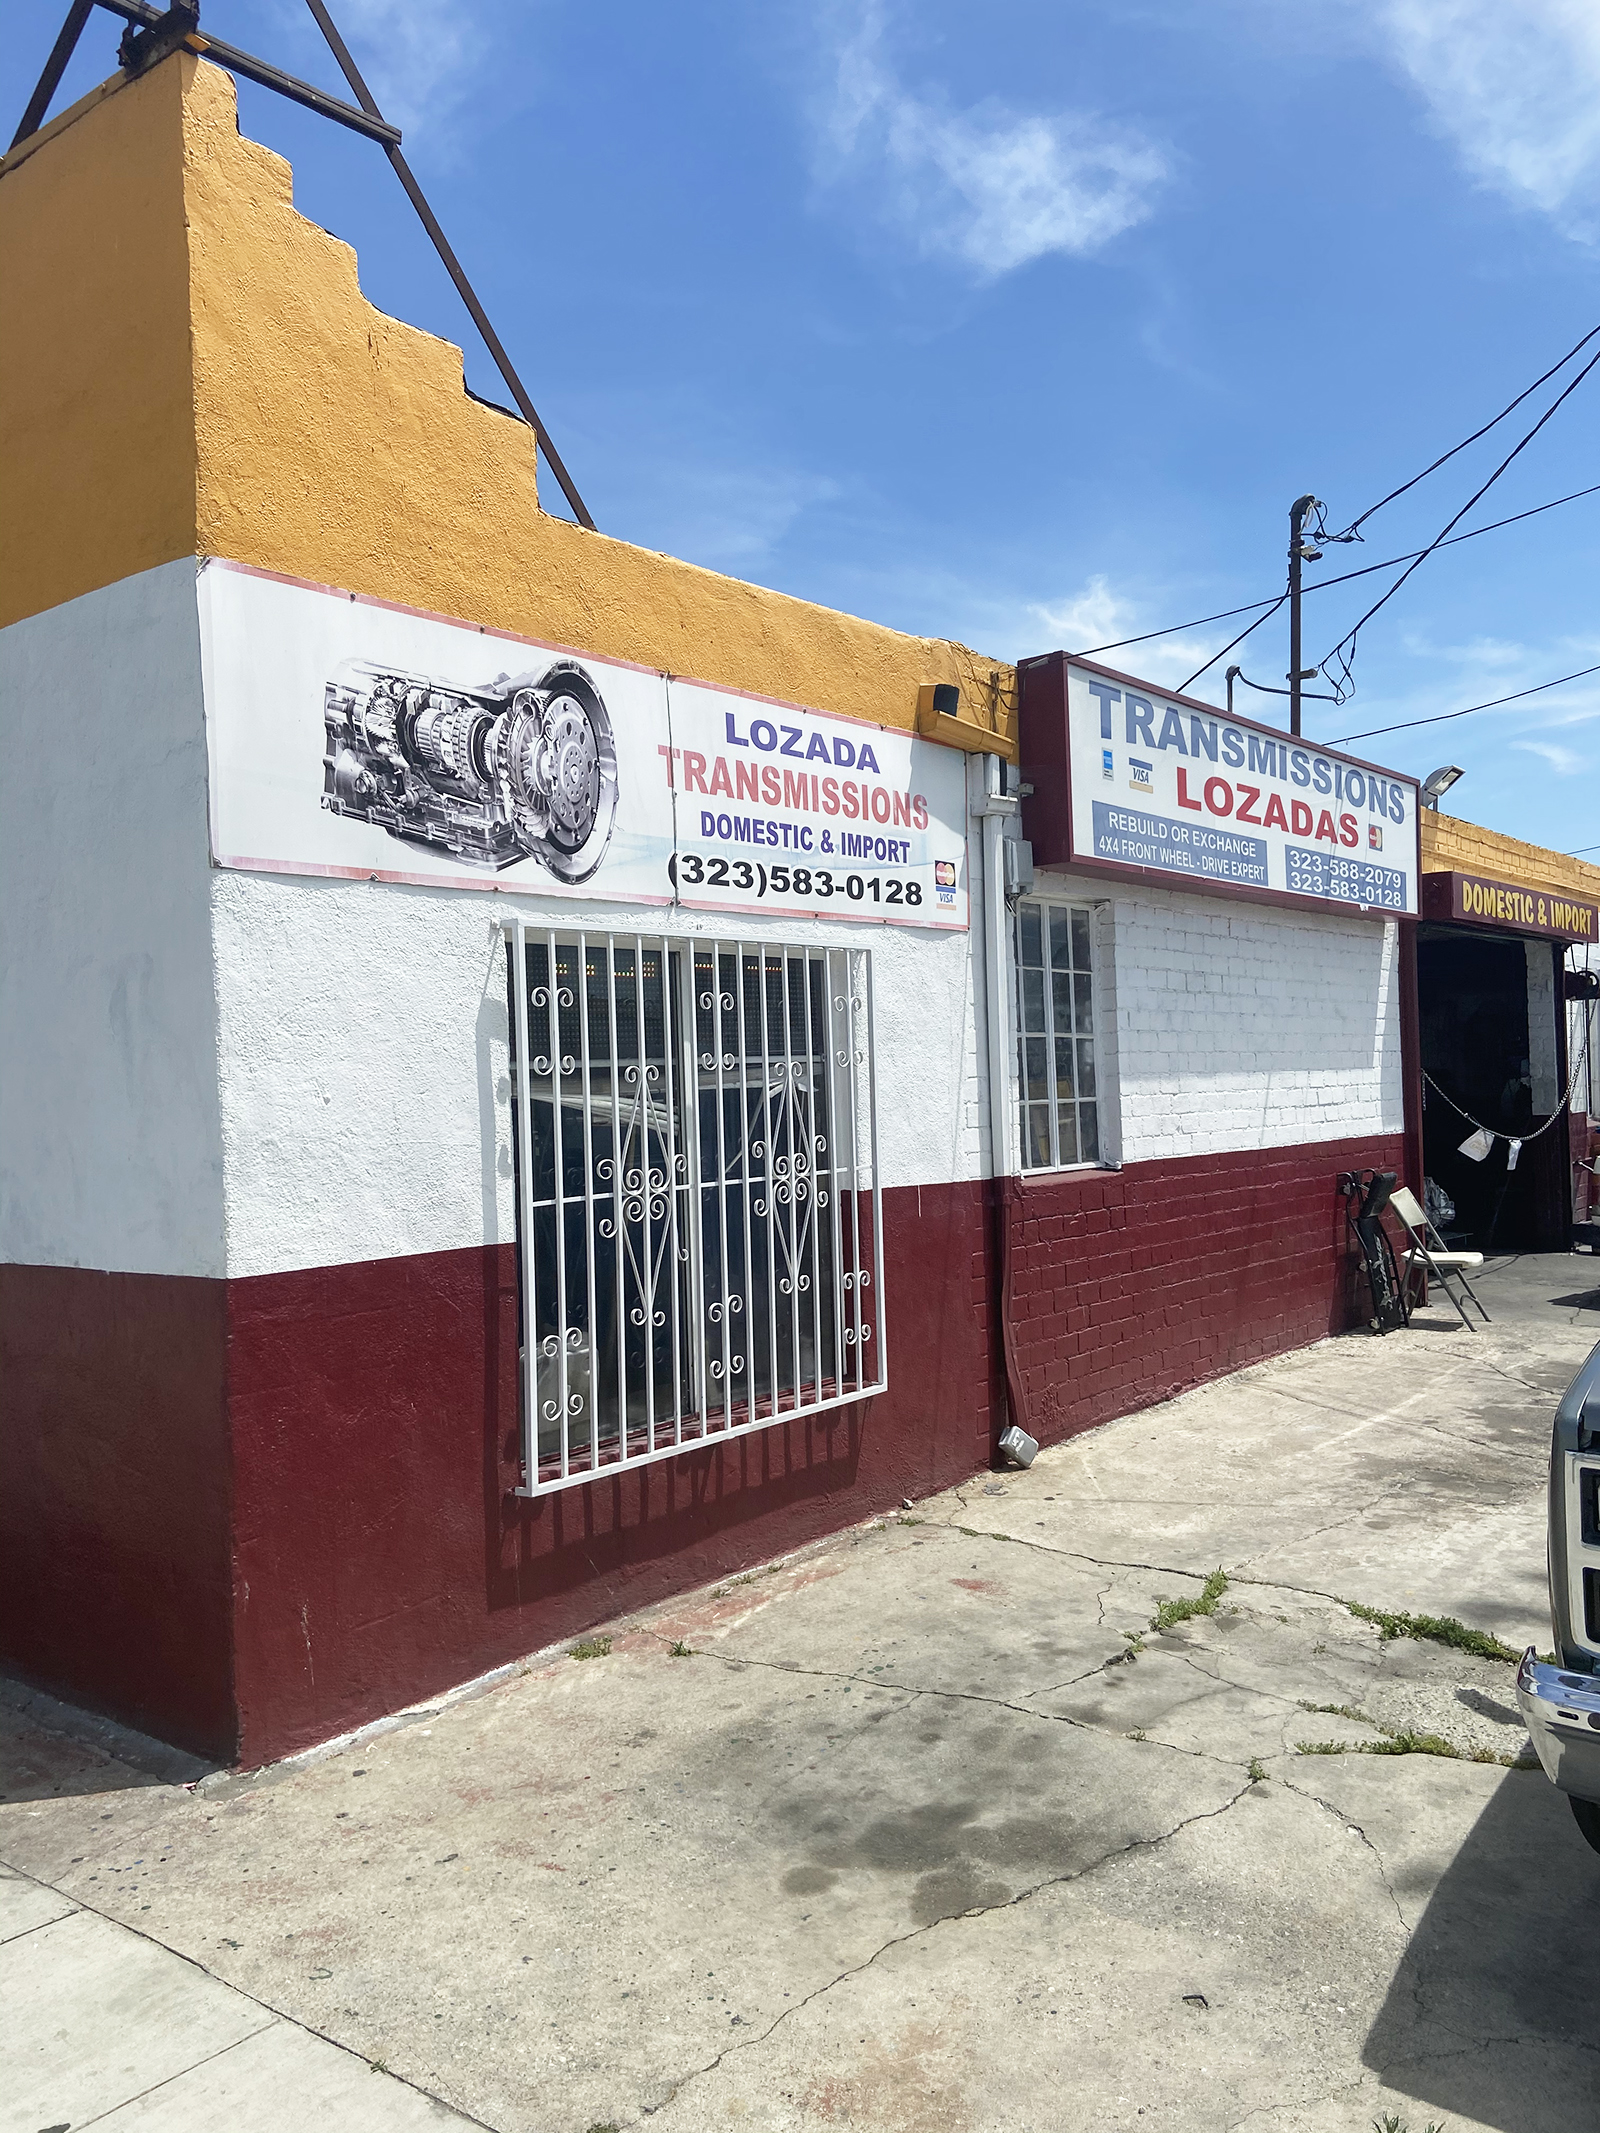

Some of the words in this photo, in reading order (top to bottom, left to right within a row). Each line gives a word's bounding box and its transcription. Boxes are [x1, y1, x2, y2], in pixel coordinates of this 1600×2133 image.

[725, 712, 880, 774] LOZADA
[1089, 680, 1405, 824] TRANSMISSIONS
[657, 744, 929, 830] TRANSMISSIONS
[1133, 767, 1149, 783] VISA
[1176, 767, 1359, 848] LOZADAS
[701, 810, 813, 851] DOMESTIC
[820, 829, 834, 853] &
[841, 832, 910, 864] IMPORT
[1099, 835, 1119, 854] 4X4
[1122, 839, 1157, 861] FRONT
[1160, 848, 1194, 868] WHEEL
[1202, 856, 1229, 875] DRIVE
[1232, 861, 1264, 881] EXPERT
[1109, 811, 1168, 839] REBUILD
[1171, 826, 1189, 844] OR
[1193, 831, 1256, 858] EXCHANGE
[668, 853, 923, 906] (323)583-0128
[1290, 850, 1401, 888] 323-588-2079
[1291, 872, 1401, 906] 323-583-0128
[939, 893, 953, 903] VISA
[1463, 880, 1534, 924] DOMESTIC
[1538, 897, 1547, 926] &
[1551, 900, 1592, 935] IMPORT
